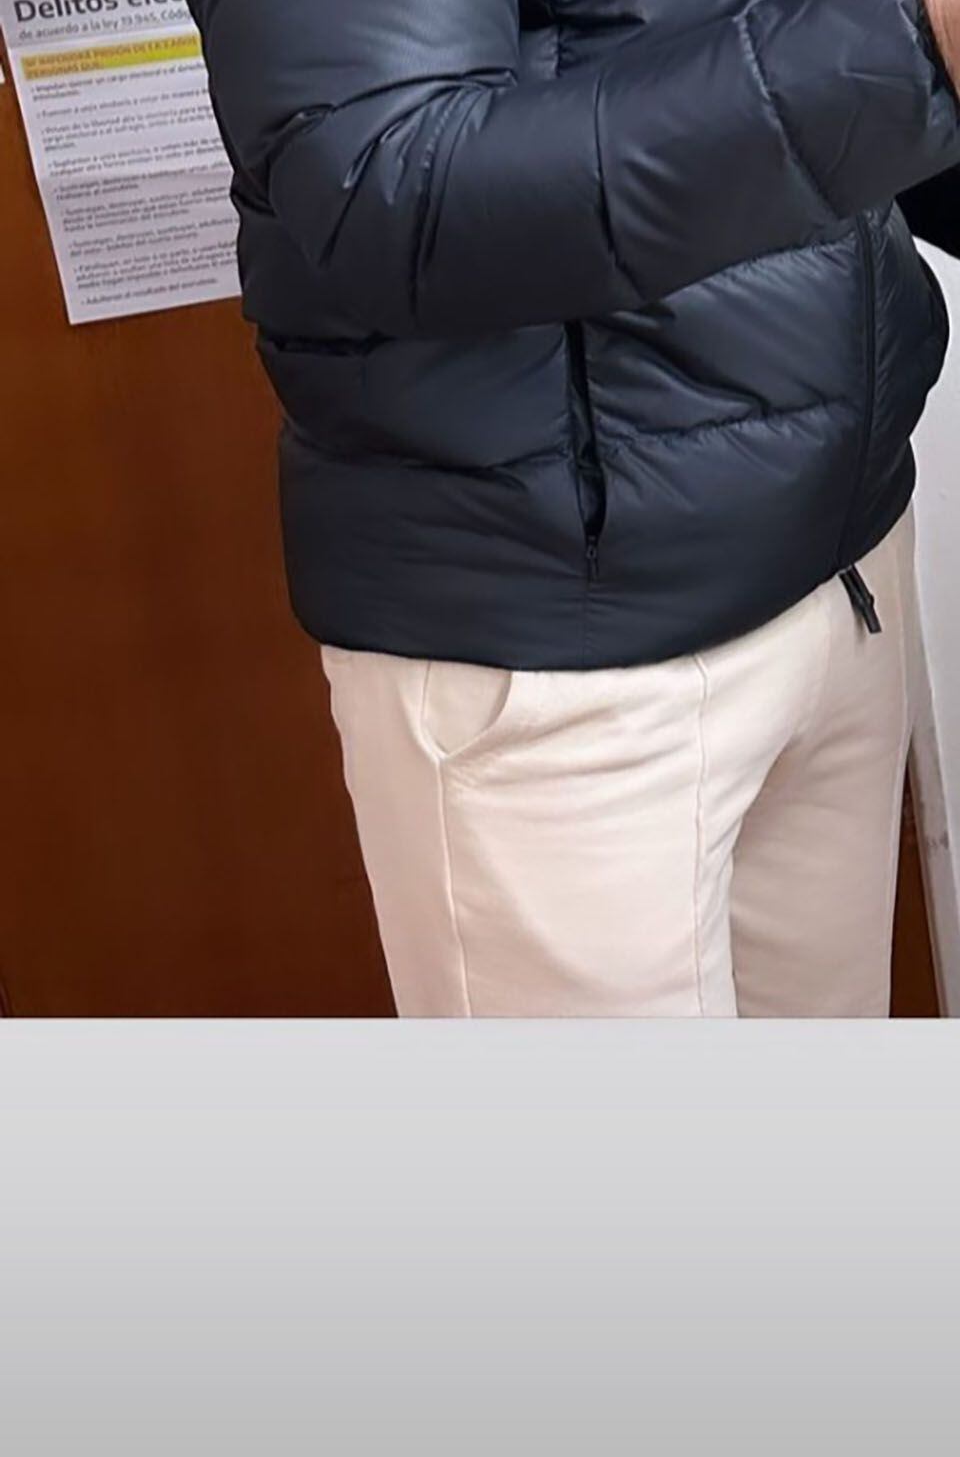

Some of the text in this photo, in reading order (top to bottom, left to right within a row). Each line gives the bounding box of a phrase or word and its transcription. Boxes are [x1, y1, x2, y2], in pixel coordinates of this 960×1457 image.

[19, 29, 34, 40] de
[35, 21, 79, 38] acuerdo
[90, 19, 101, 30] la
[103, 17, 119, 32] ley
